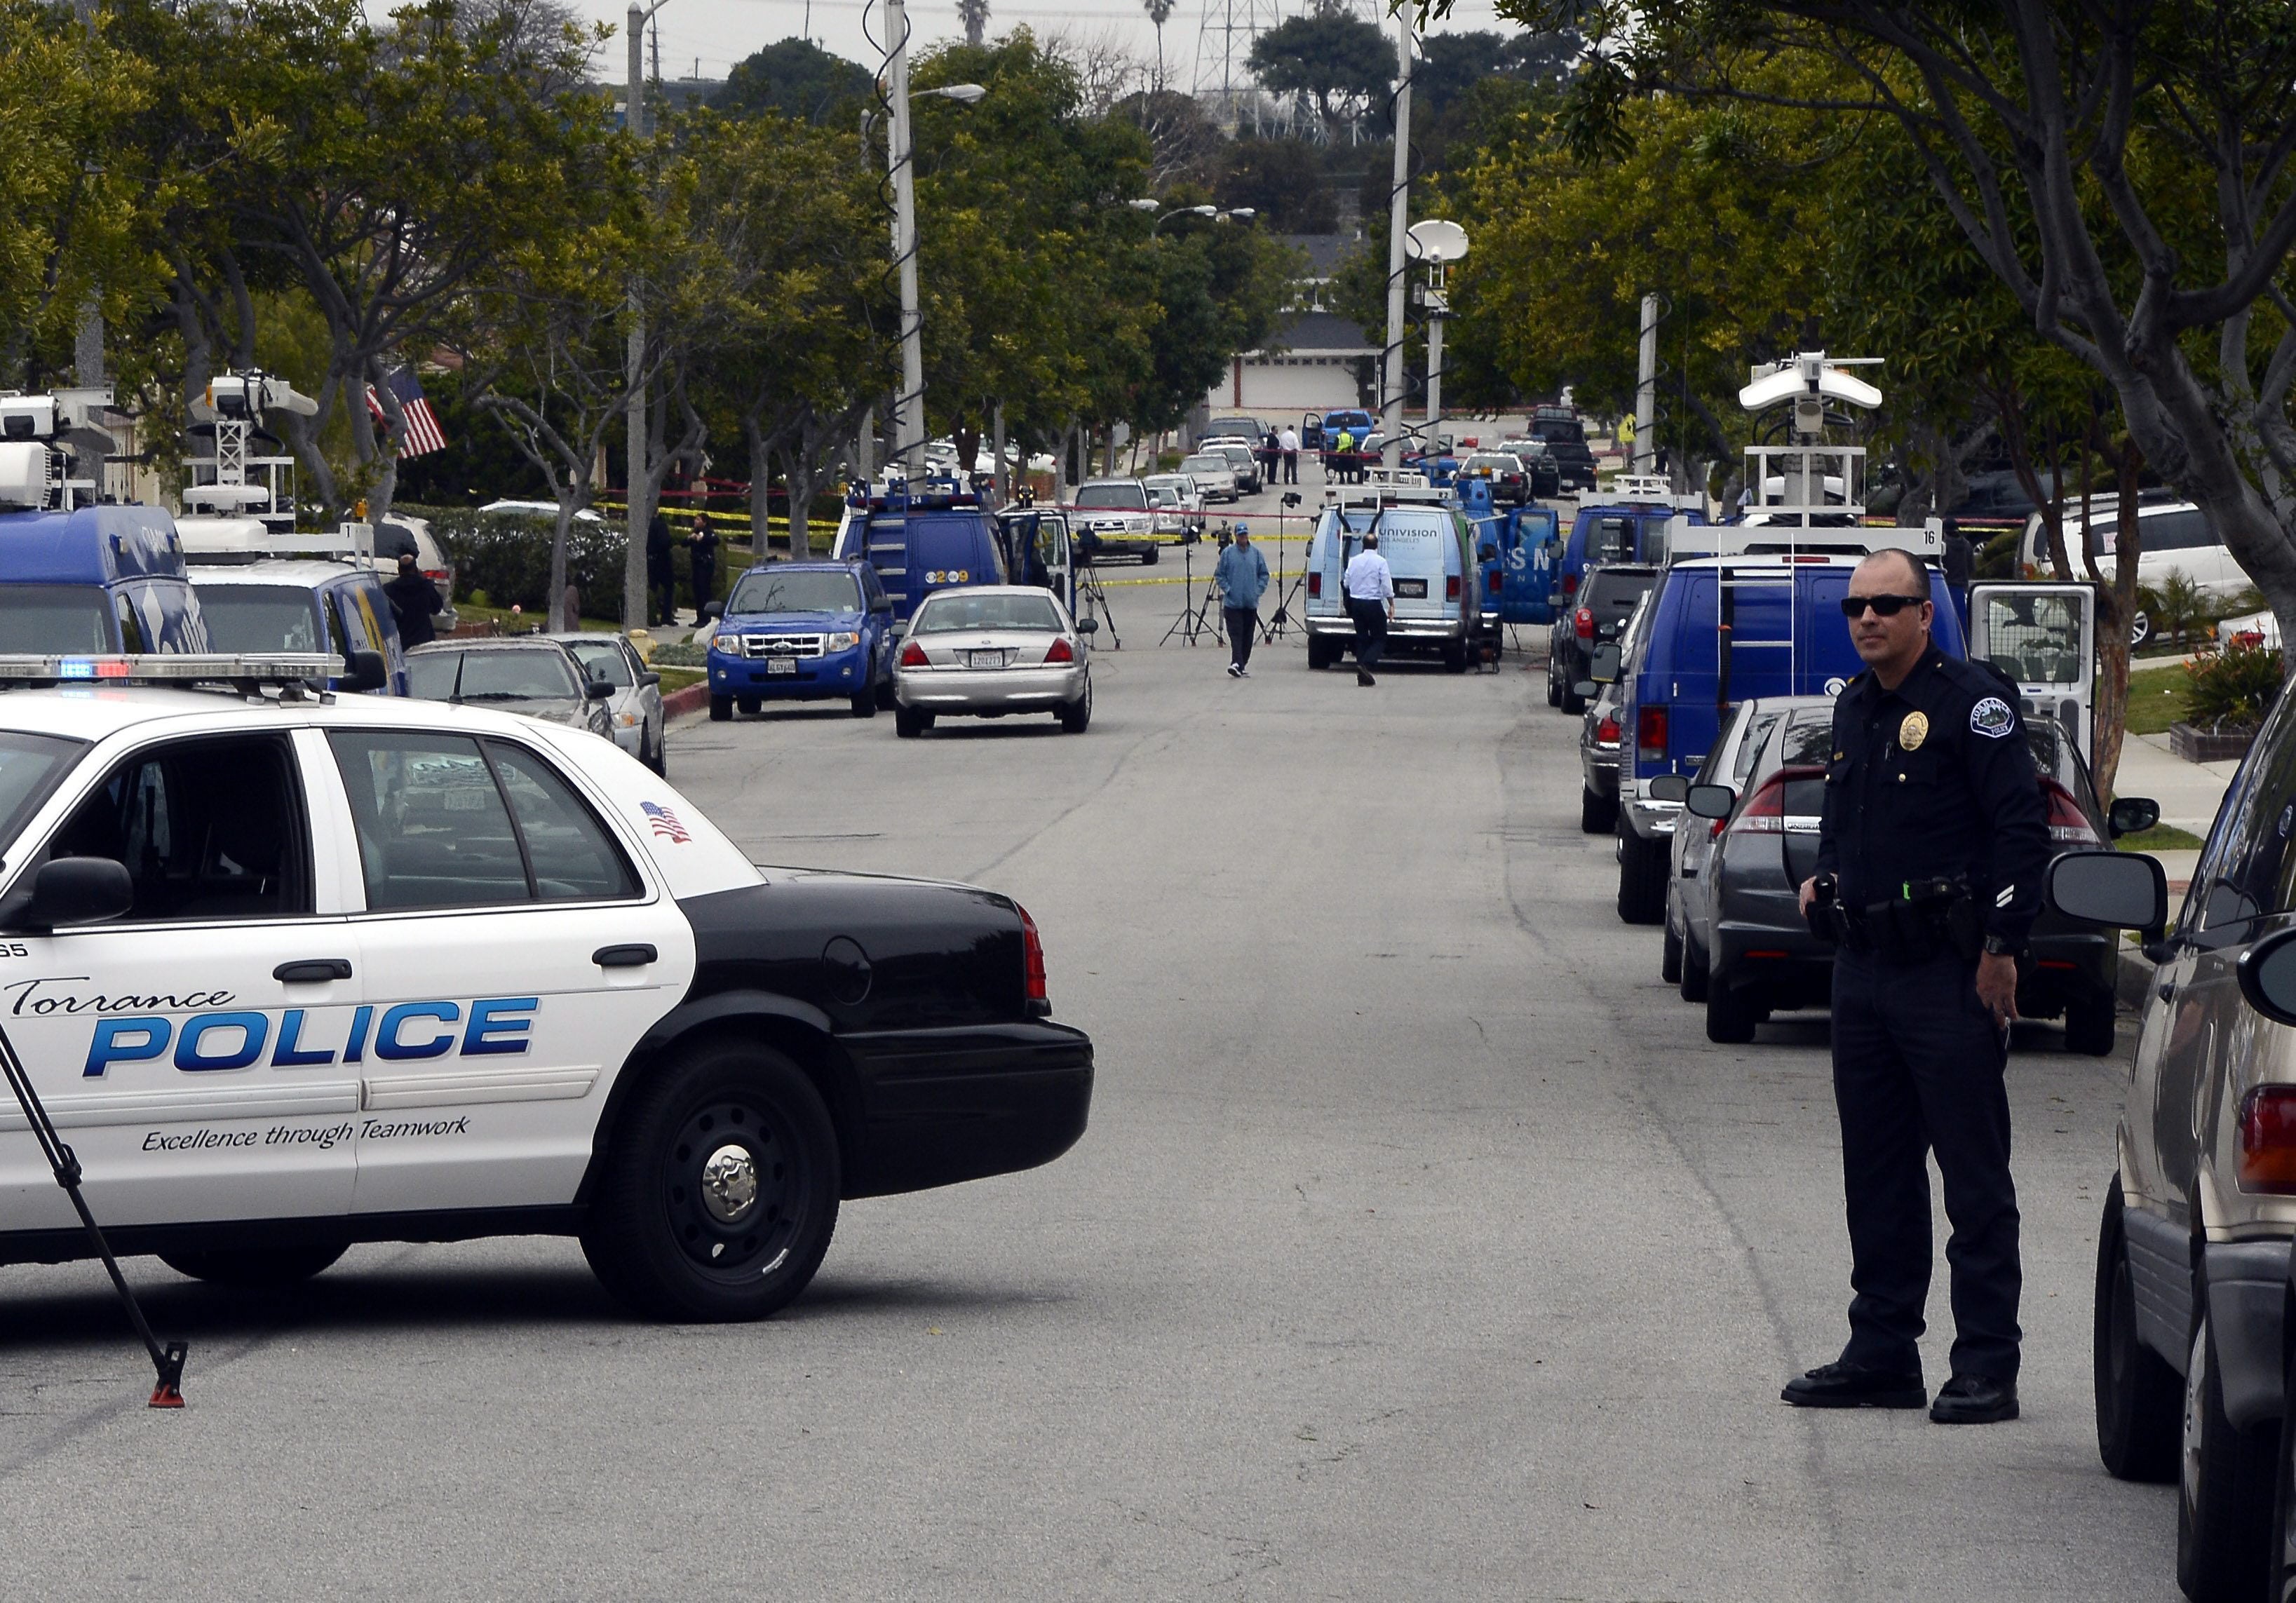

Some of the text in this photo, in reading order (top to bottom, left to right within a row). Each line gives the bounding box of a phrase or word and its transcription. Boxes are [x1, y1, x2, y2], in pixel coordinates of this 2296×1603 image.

[912, 496, 921, 504] 24
[1924, 531, 1935, 544] 16
[936, 570, 945, 583] 2
[959, 569, 968, 582] 9
[4, 976, 236, 1015] Torrance
[82, 996, 539, 1077] POLICE
[142, 1116, 470, 1151] Excellence through Teamwork
